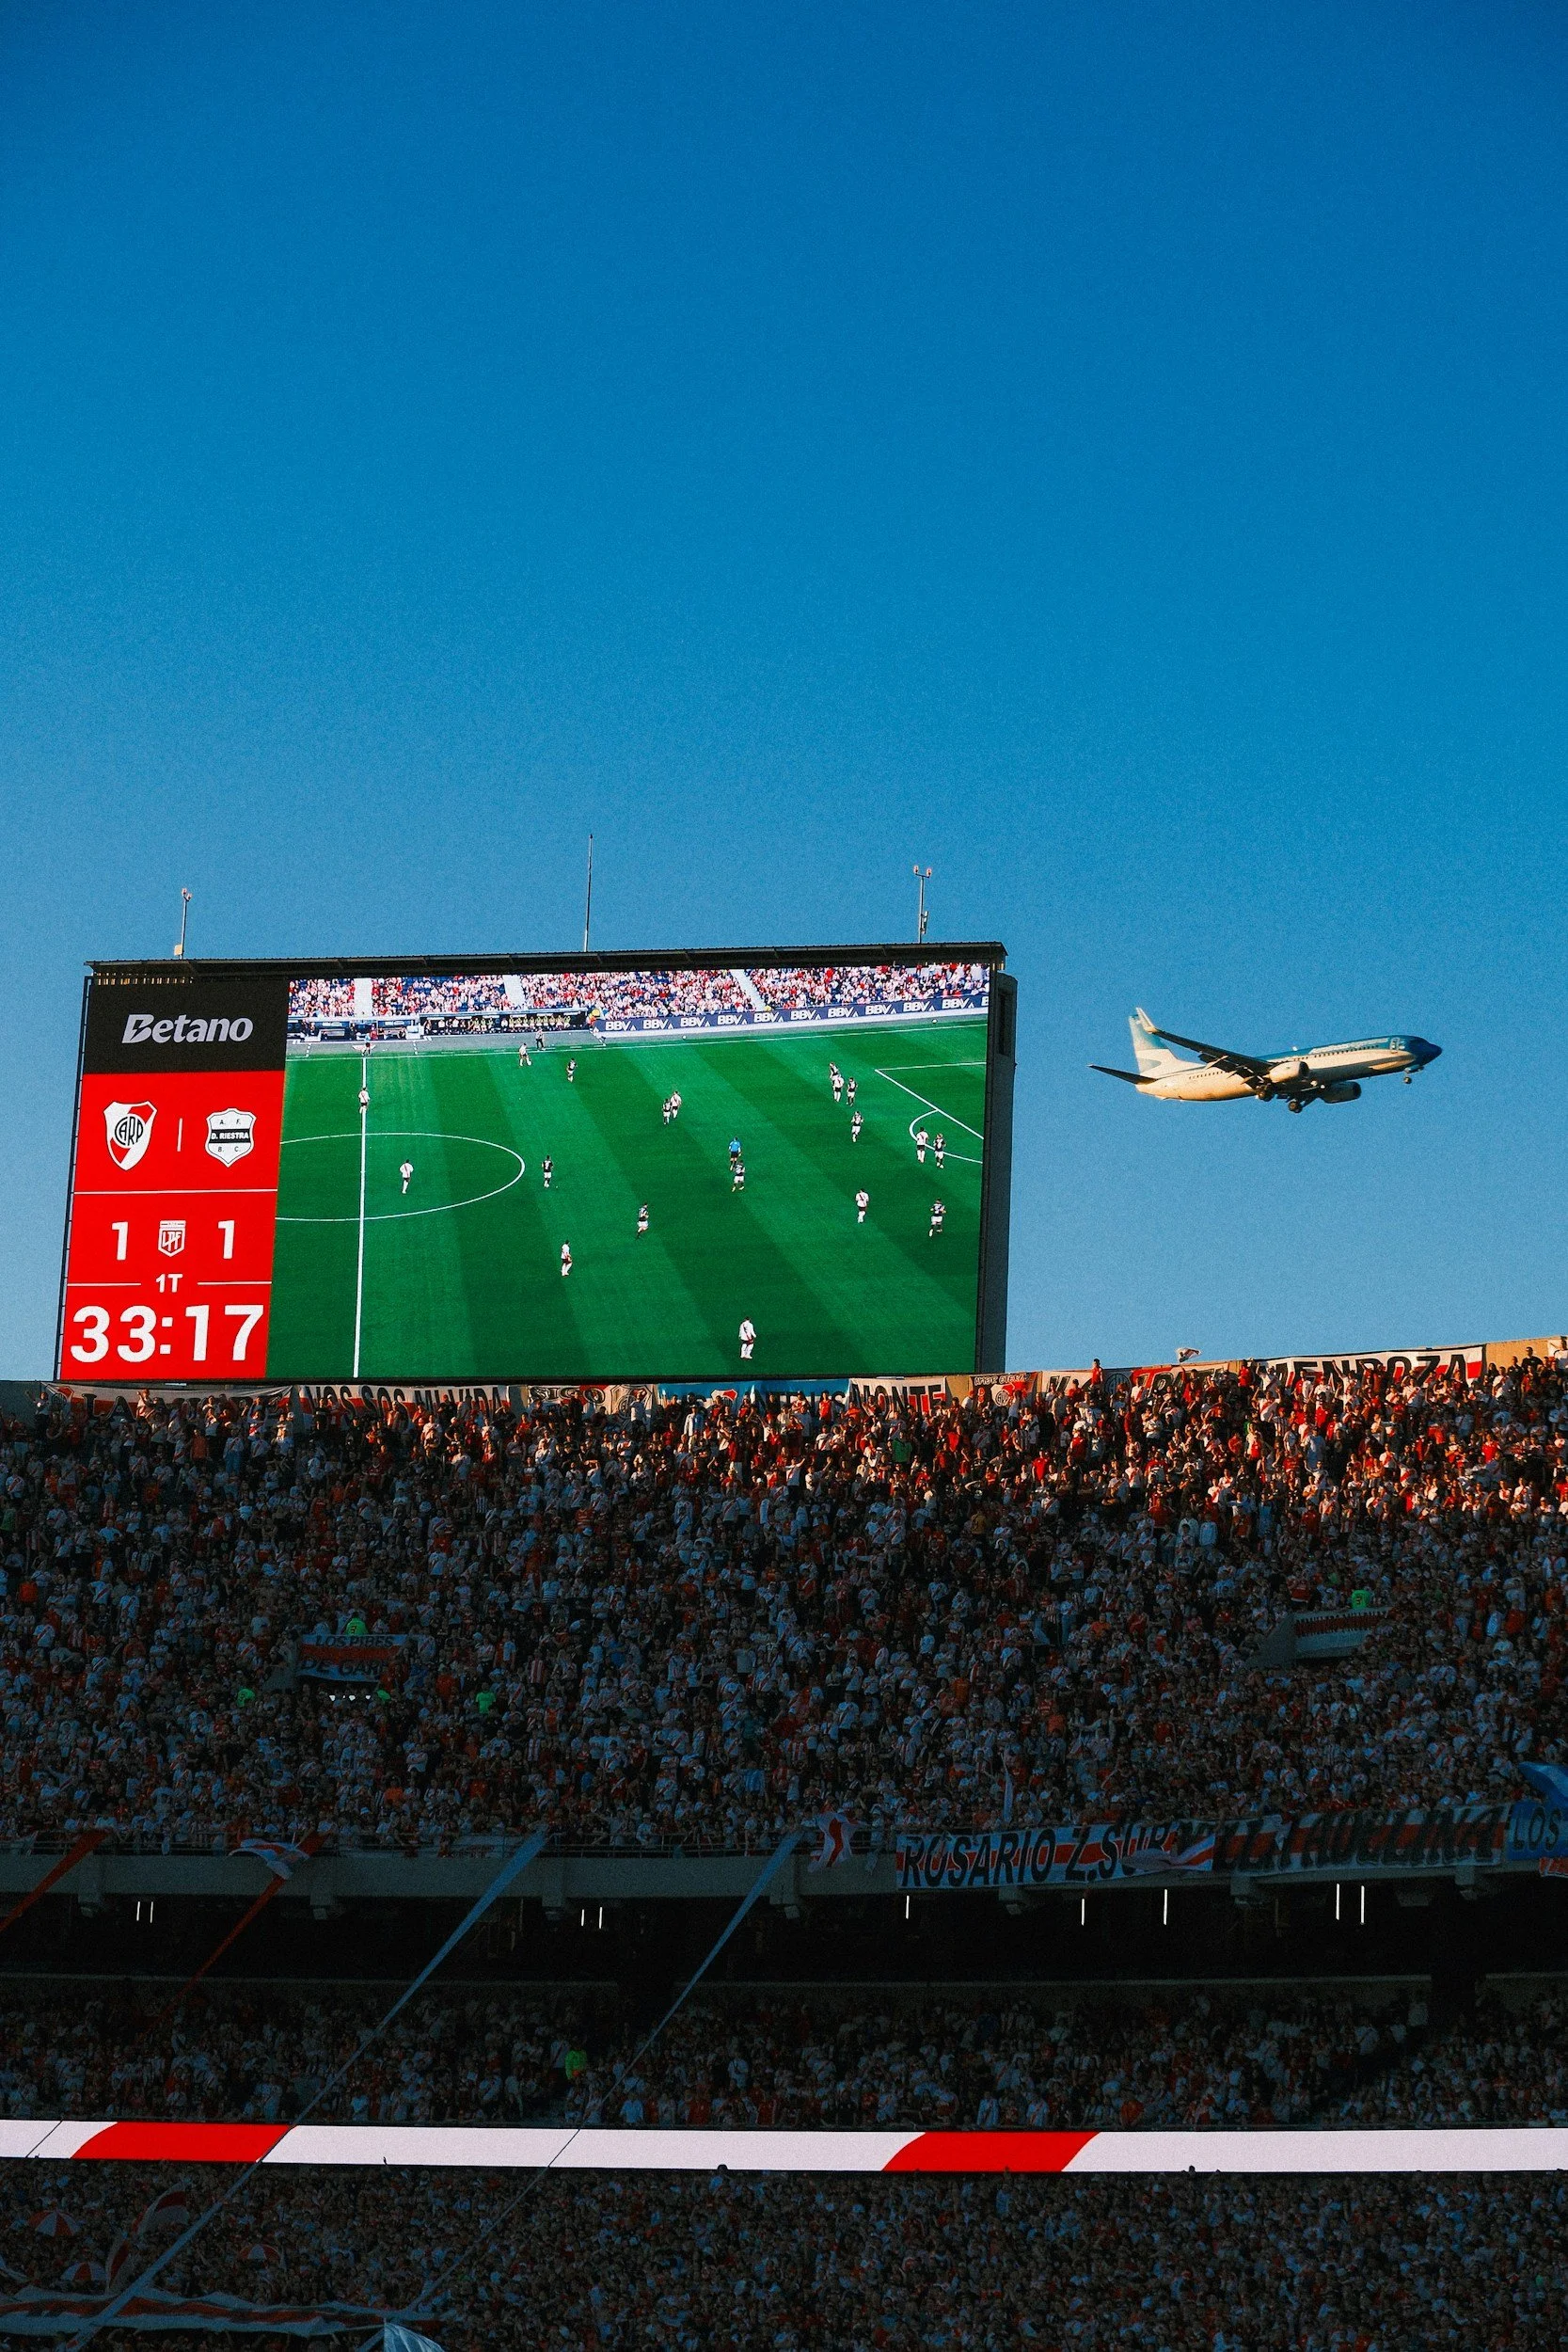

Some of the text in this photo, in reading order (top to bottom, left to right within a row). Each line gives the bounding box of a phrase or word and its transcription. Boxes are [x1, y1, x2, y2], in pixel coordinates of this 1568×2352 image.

[122, 1013, 253, 1044] Betano
[111, 1222, 129, 1261] 1
[217, 1220, 235, 1259] 1
[155, 1274, 183, 1293] 1T
[70, 1305, 264, 1363] 33:17
[316, 1635, 394, 1647] LOS PIBES
[1513, 1805, 1563, 1854] LOS
[901, 1832, 1057, 1887] ROSARIO
